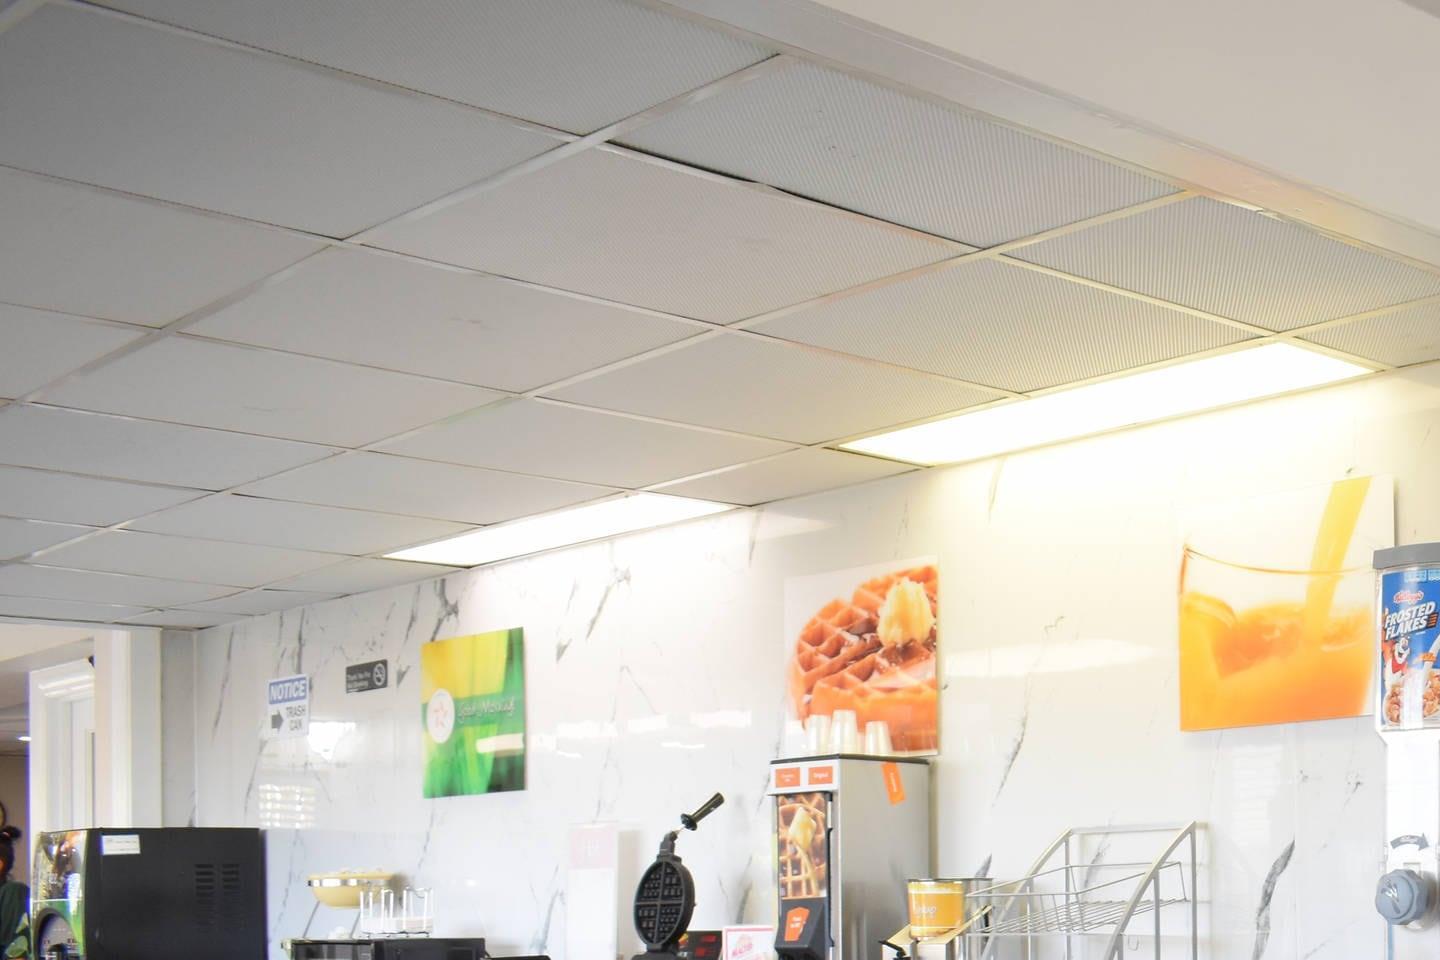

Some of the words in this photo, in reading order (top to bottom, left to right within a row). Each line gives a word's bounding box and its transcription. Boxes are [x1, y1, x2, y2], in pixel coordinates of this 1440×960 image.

[1385, 601, 1437, 629] FROSTED
[1385, 615, 1429, 641] FLAKES
[269, 680, 307, 701] NOTICE
[285, 704, 306, 717] TRASH
